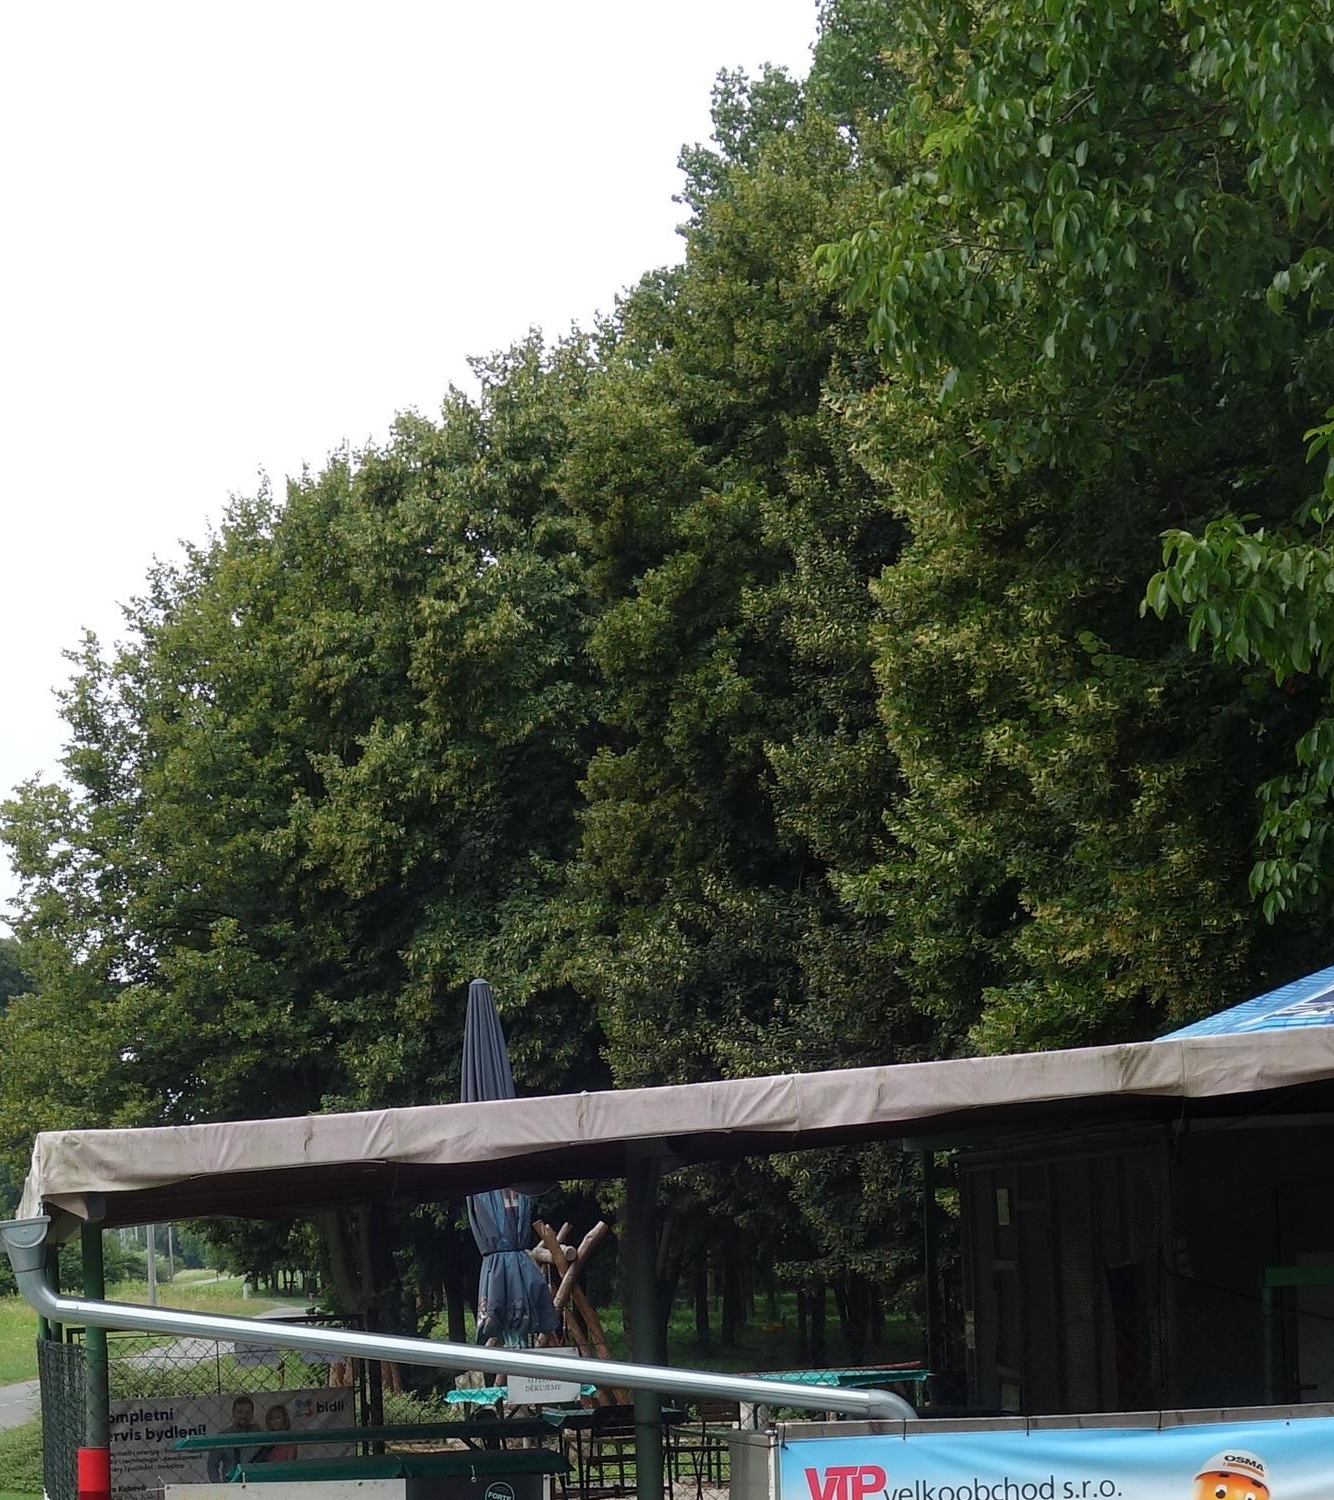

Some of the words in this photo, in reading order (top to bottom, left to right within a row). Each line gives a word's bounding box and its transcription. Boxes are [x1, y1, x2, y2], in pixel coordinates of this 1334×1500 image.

[109, 1408, 173, 1425] ompletní
[1224, 1455, 1264, 1472] OSMA
[1062, 1479, 1122, 1500] s.r.o.
